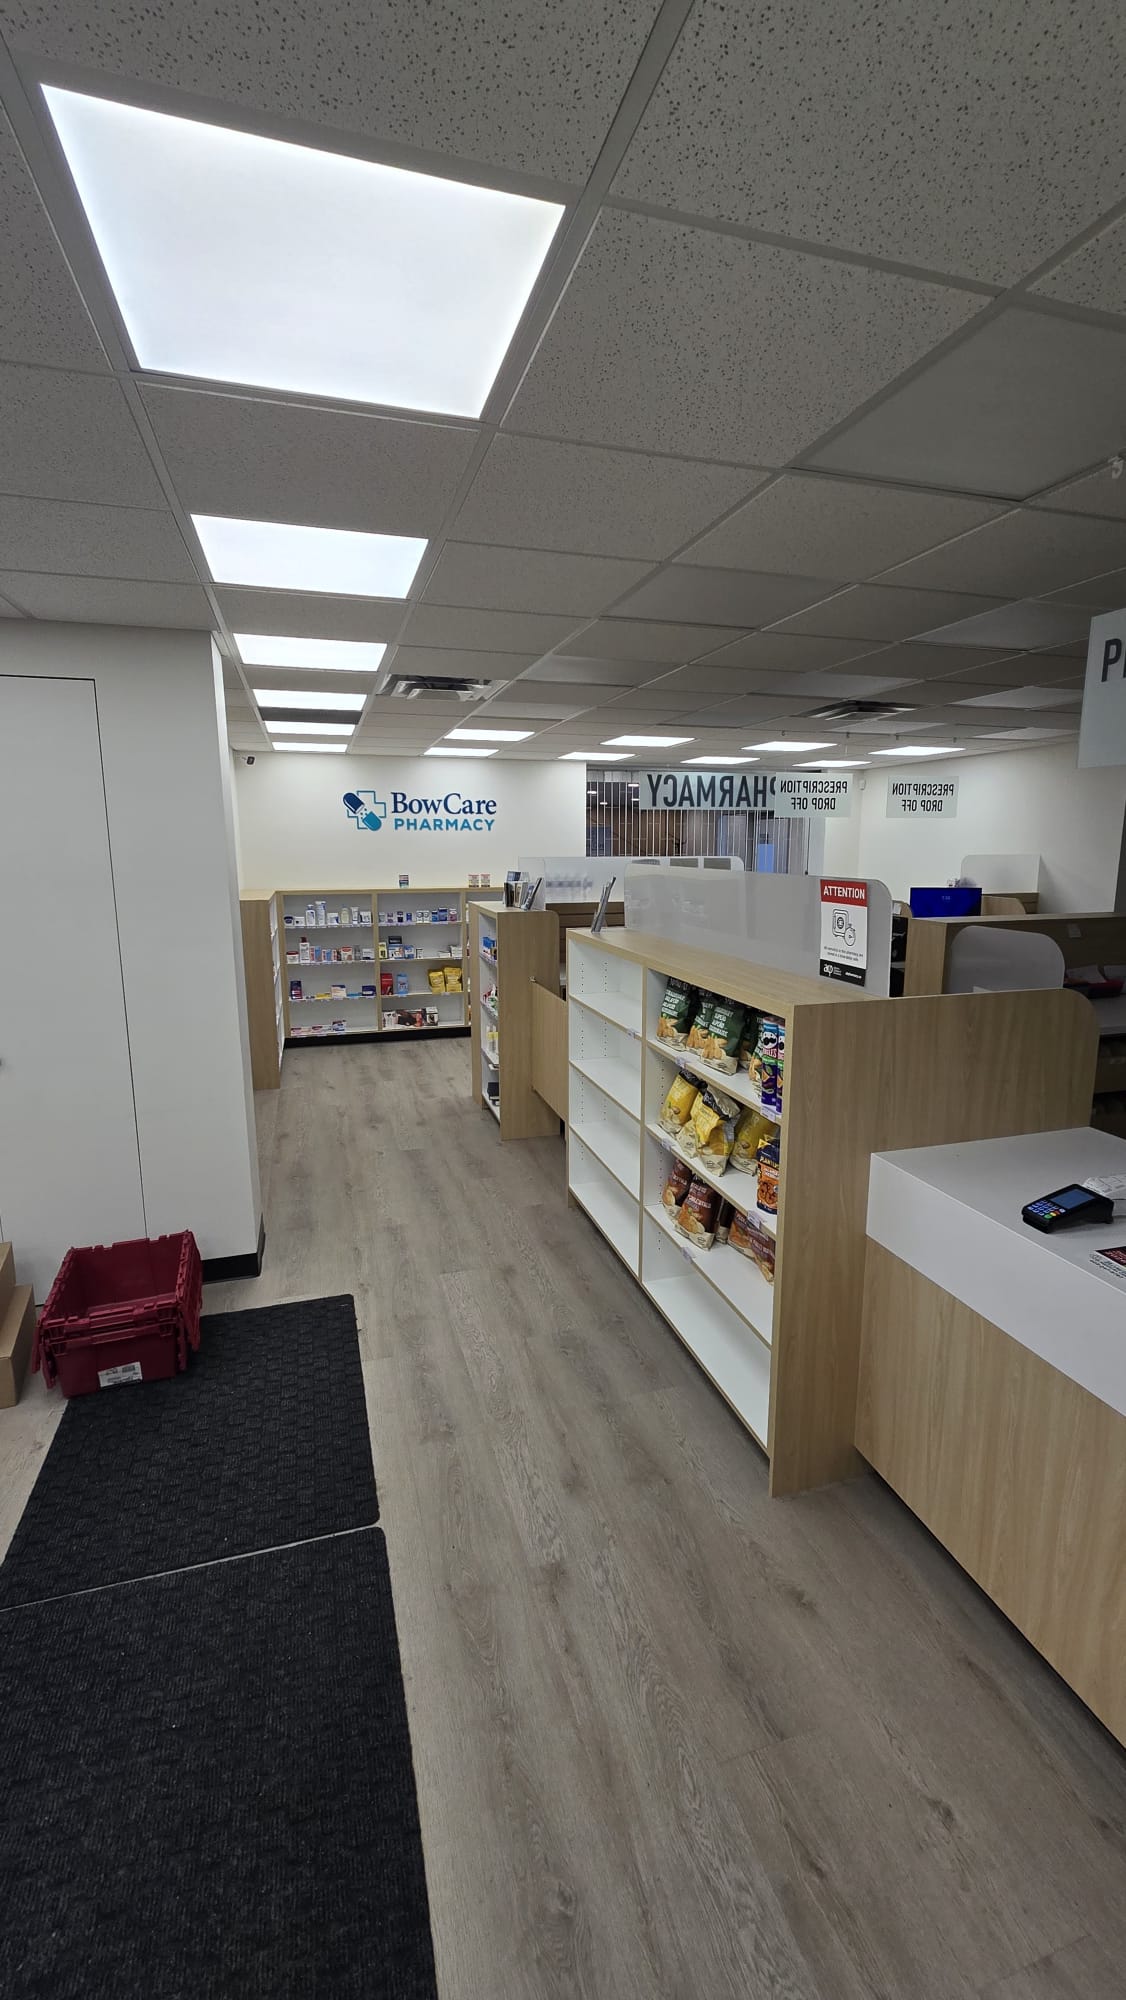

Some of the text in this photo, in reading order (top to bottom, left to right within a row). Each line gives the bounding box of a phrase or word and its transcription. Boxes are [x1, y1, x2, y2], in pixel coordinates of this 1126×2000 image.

[1101, 638, 1126, 683] P
[391, 792, 497, 815] BowCare
[394, 818, 495, 831] PHARMACY
[823, 885, 865, 900] ATTENTION
